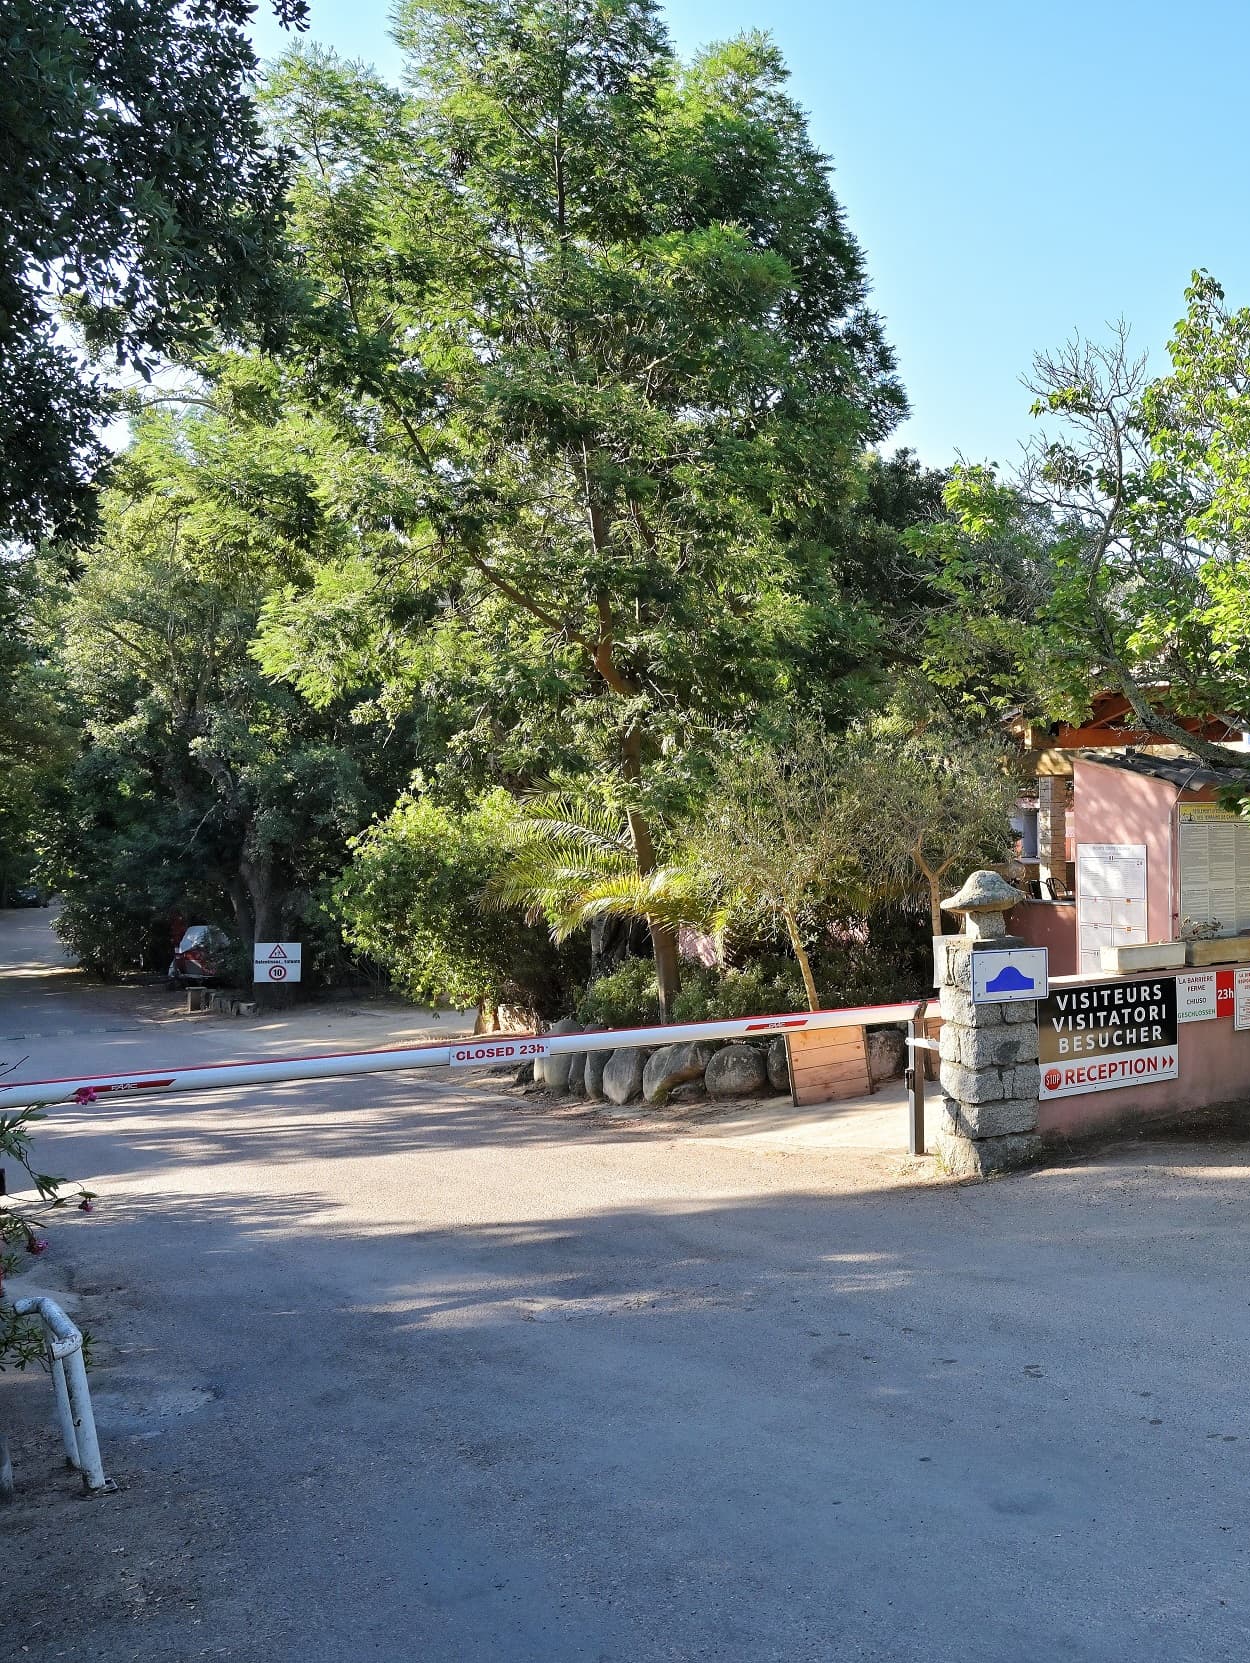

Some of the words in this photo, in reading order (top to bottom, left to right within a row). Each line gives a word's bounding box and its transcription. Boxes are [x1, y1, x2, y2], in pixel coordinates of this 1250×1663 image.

[273, 969, 283, 977] 10
[1056, 984, 1162, 1011] VISITEURS
[1186, 997, 1207, 1005] CHIUSO
[1217, 988, 1234, 1000] 23h
[1052, 1004, 1166, 1033] VISITATORI
[1178, 1008, 1216, 1019] GESCHLOSSEN
[1058, 1025, 1162, 1054] BESUCHER
[456, 1046, 515, 1061] CLOSED
[519, 1044, 545, 1055] 23h
[1045, 1072, 1061, 1085] STOP
[1065, 1056, 1158, 1086] RECEPTION
